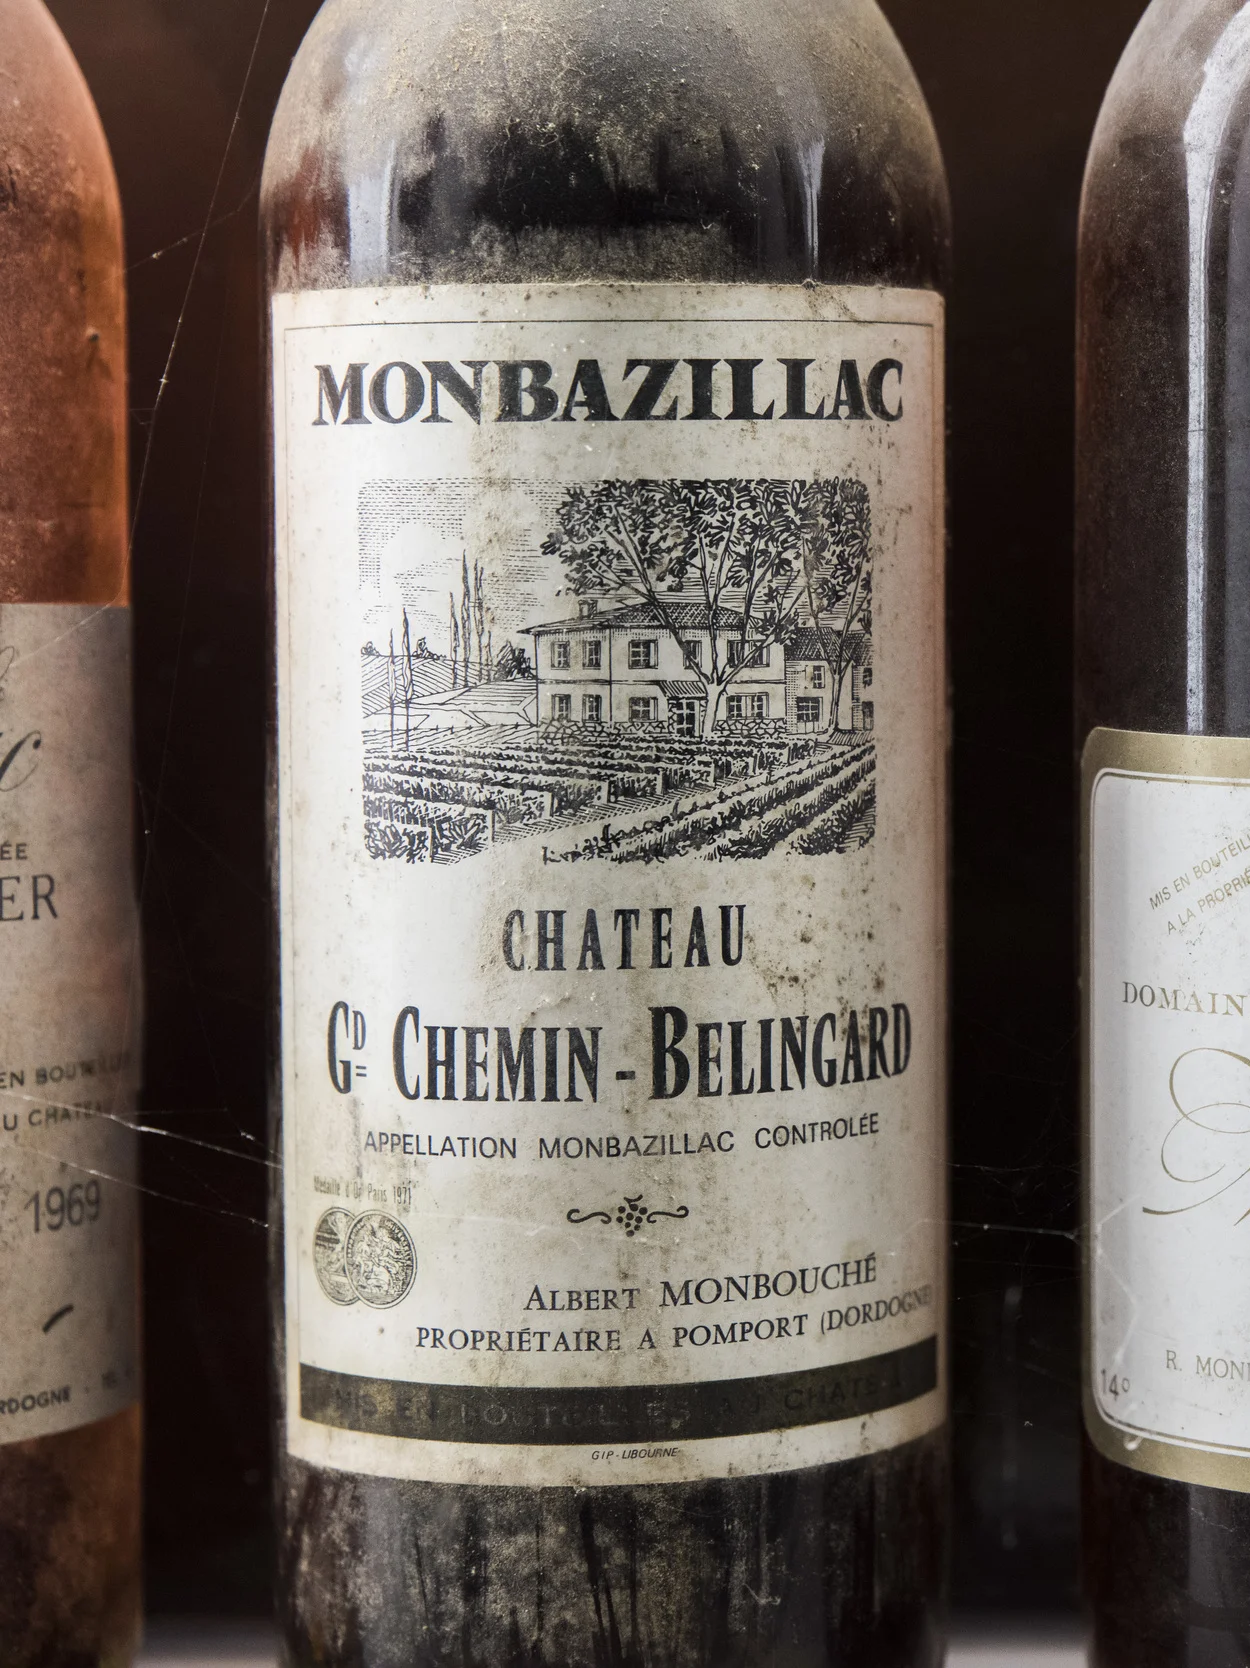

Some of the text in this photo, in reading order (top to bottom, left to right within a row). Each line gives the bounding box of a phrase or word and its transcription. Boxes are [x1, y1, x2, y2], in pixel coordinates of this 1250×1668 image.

[312, 358, 903, 426] MONBAZILLAC
[1150, 887, 1171, 910] MIS
[1173, 873, 1191, 893] EN
[502, 904, 747, 972] CHATEAU
[1168, 920, 1177, 935] A
[1178, 907, 1197, 926] LA
[393, 1005, 602, 1102] CHEMIN
[648, 1003, 912, 1100] BELINGARD
[363, 1112, 879, 1159] APPELLATION MONBAZILLAC CONTROLÉE
[24, 1179, 101, 1233] 1969
[524, 1252, 877, 1312] ALBERT MONBOUCHÉ
[416, 1321, 621, 1353] PROPRIÉTAIRE
[638, 1330, 656, 1351] A
[673, 1313, 808, 1349] POMPORT
[1166, 1349, 1182, 1371] R.
